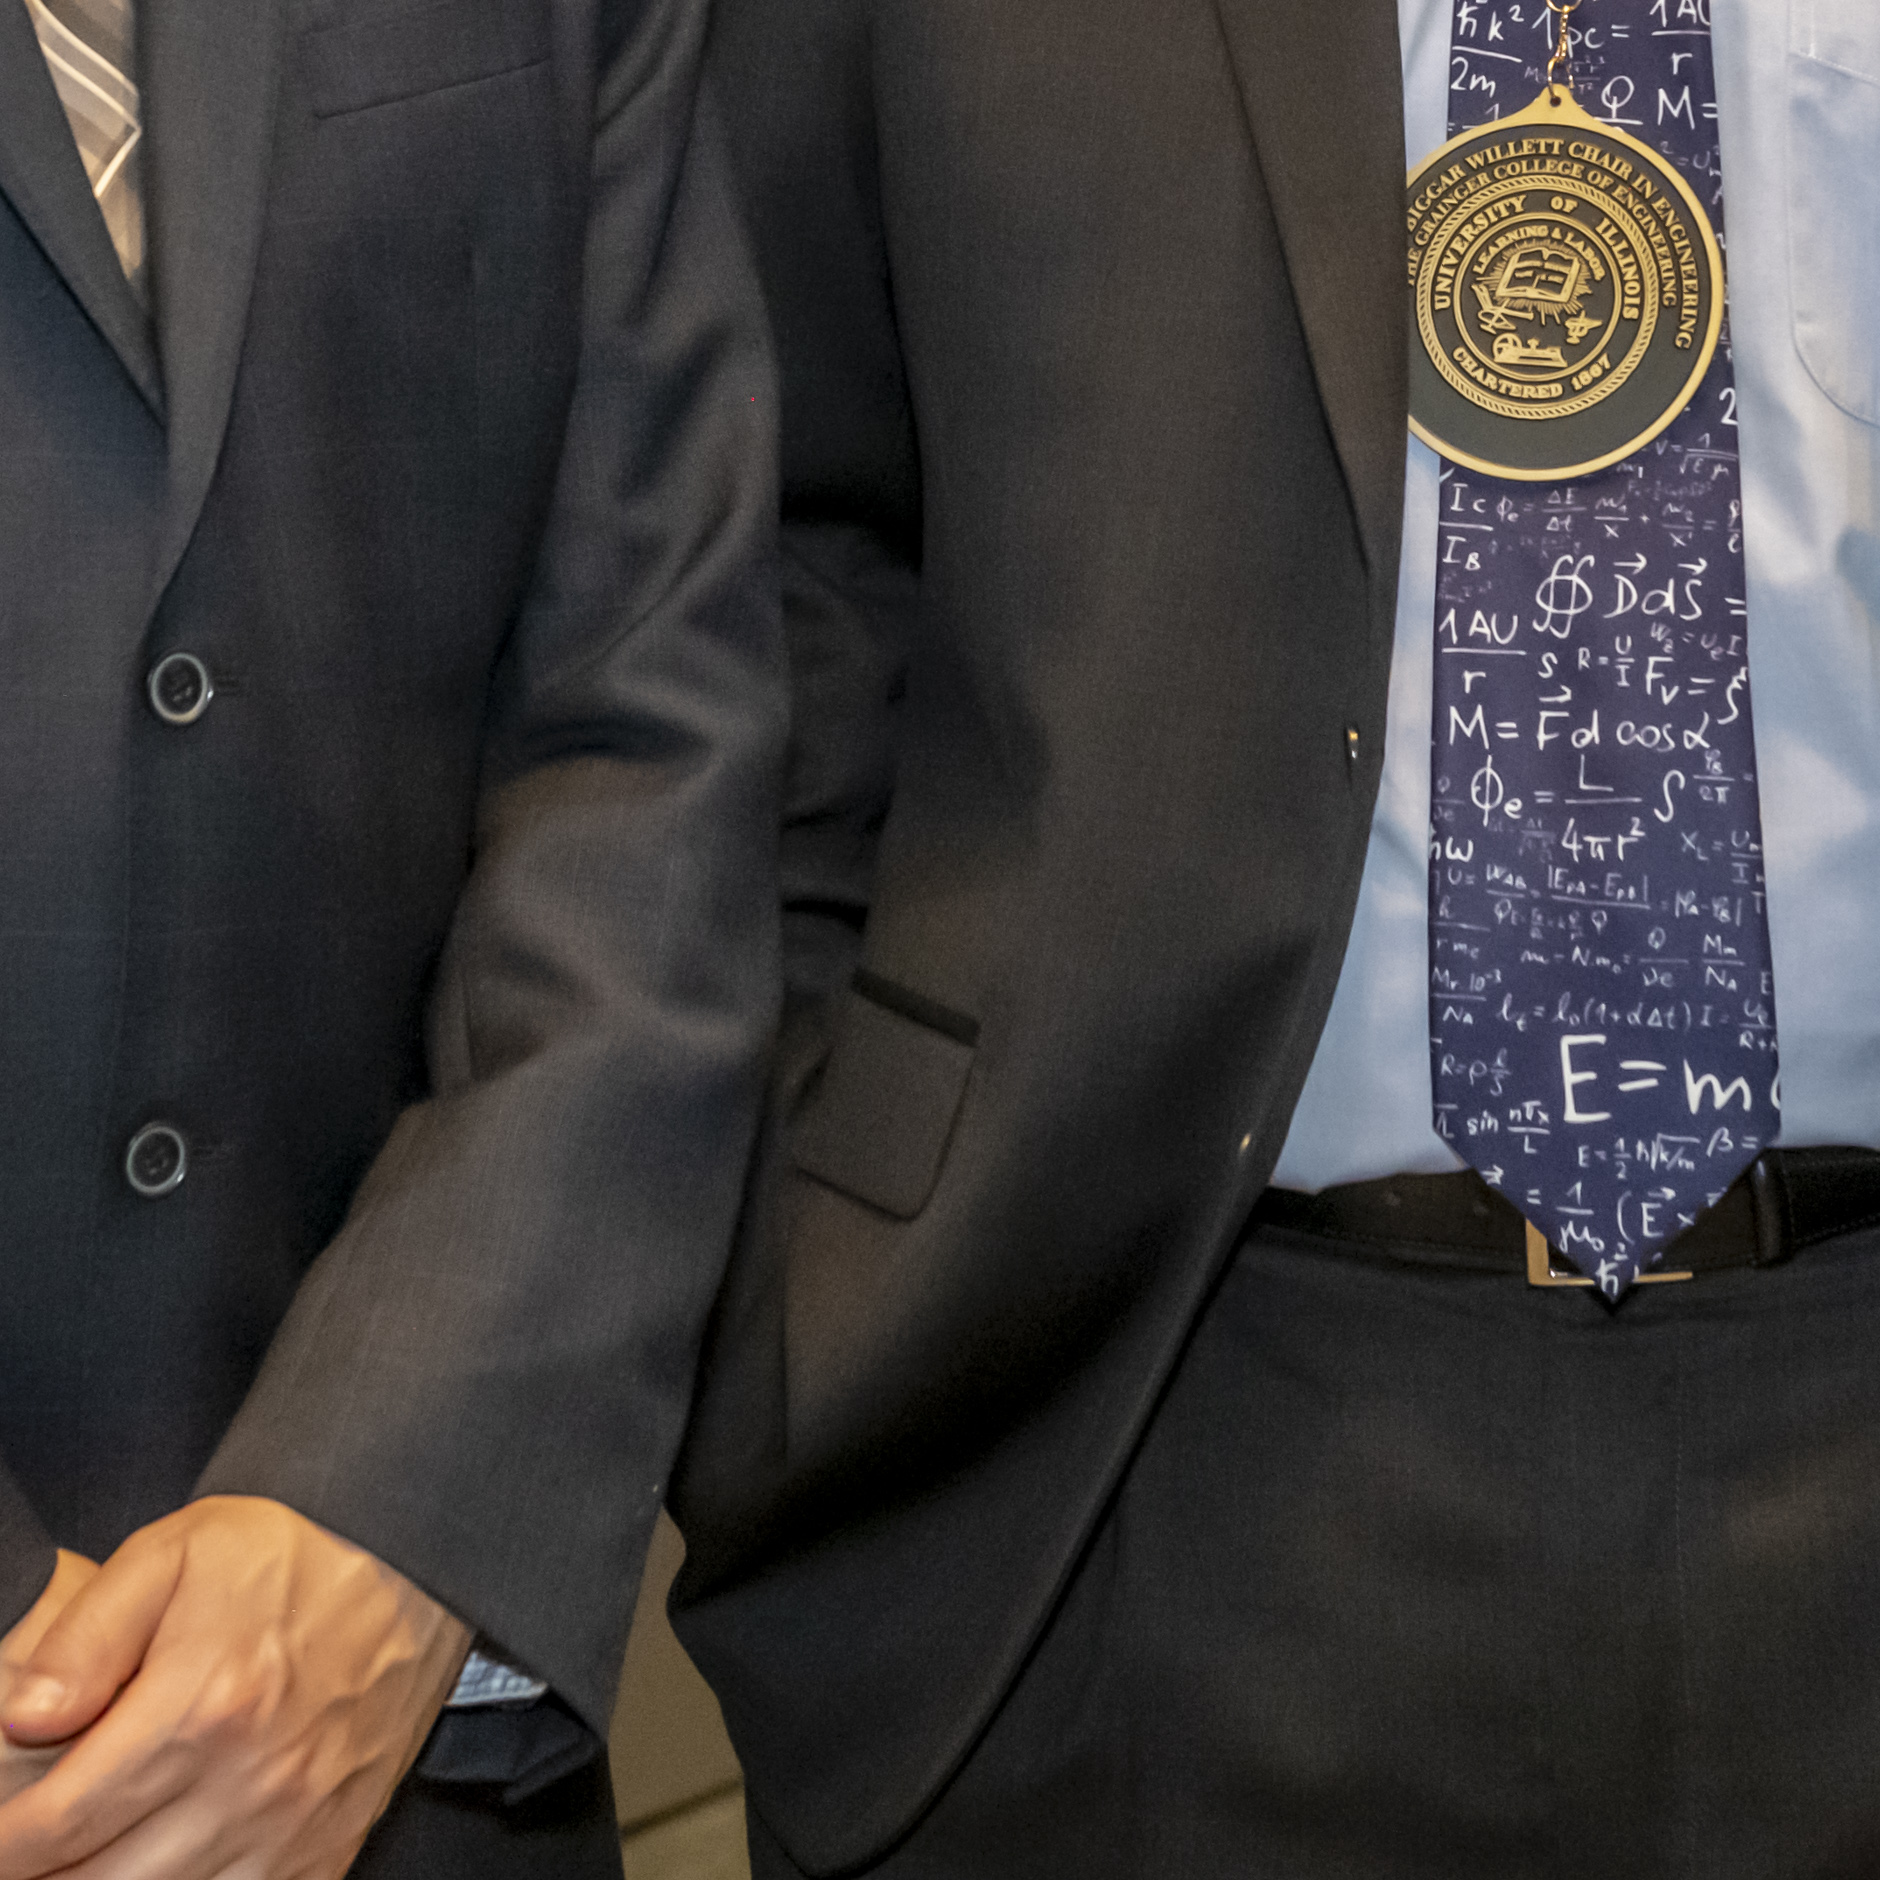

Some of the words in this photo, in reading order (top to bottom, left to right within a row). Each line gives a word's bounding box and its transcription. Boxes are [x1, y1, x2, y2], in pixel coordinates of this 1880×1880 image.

[1414, 172, 1492, 246] GRAINGER
[1493, 158, 1585, 180] COLLEGE
[1587, 171, 1614, 191] OF
[1612, 185, 1677, 308] ENGINEERING
[1434, 194, 1527, 311] UNIVERSITY
[1550, 196, 1578, 213] OF
[1595, 217, 1642, 320] ILLINOIS
[1464, 138, 1564, 170] WILLETT
[1568, 141, 1634, 181] CHAIR
[1631, 174, 1658, 200] IN
[1652, 196, 1700, 350] ENGINEERING
[1473, 225, 1549, 275] LEARNING
[1564, 232, 1606, 281] LABOR
[1452, 346, 1564, 399] CHARTERED
